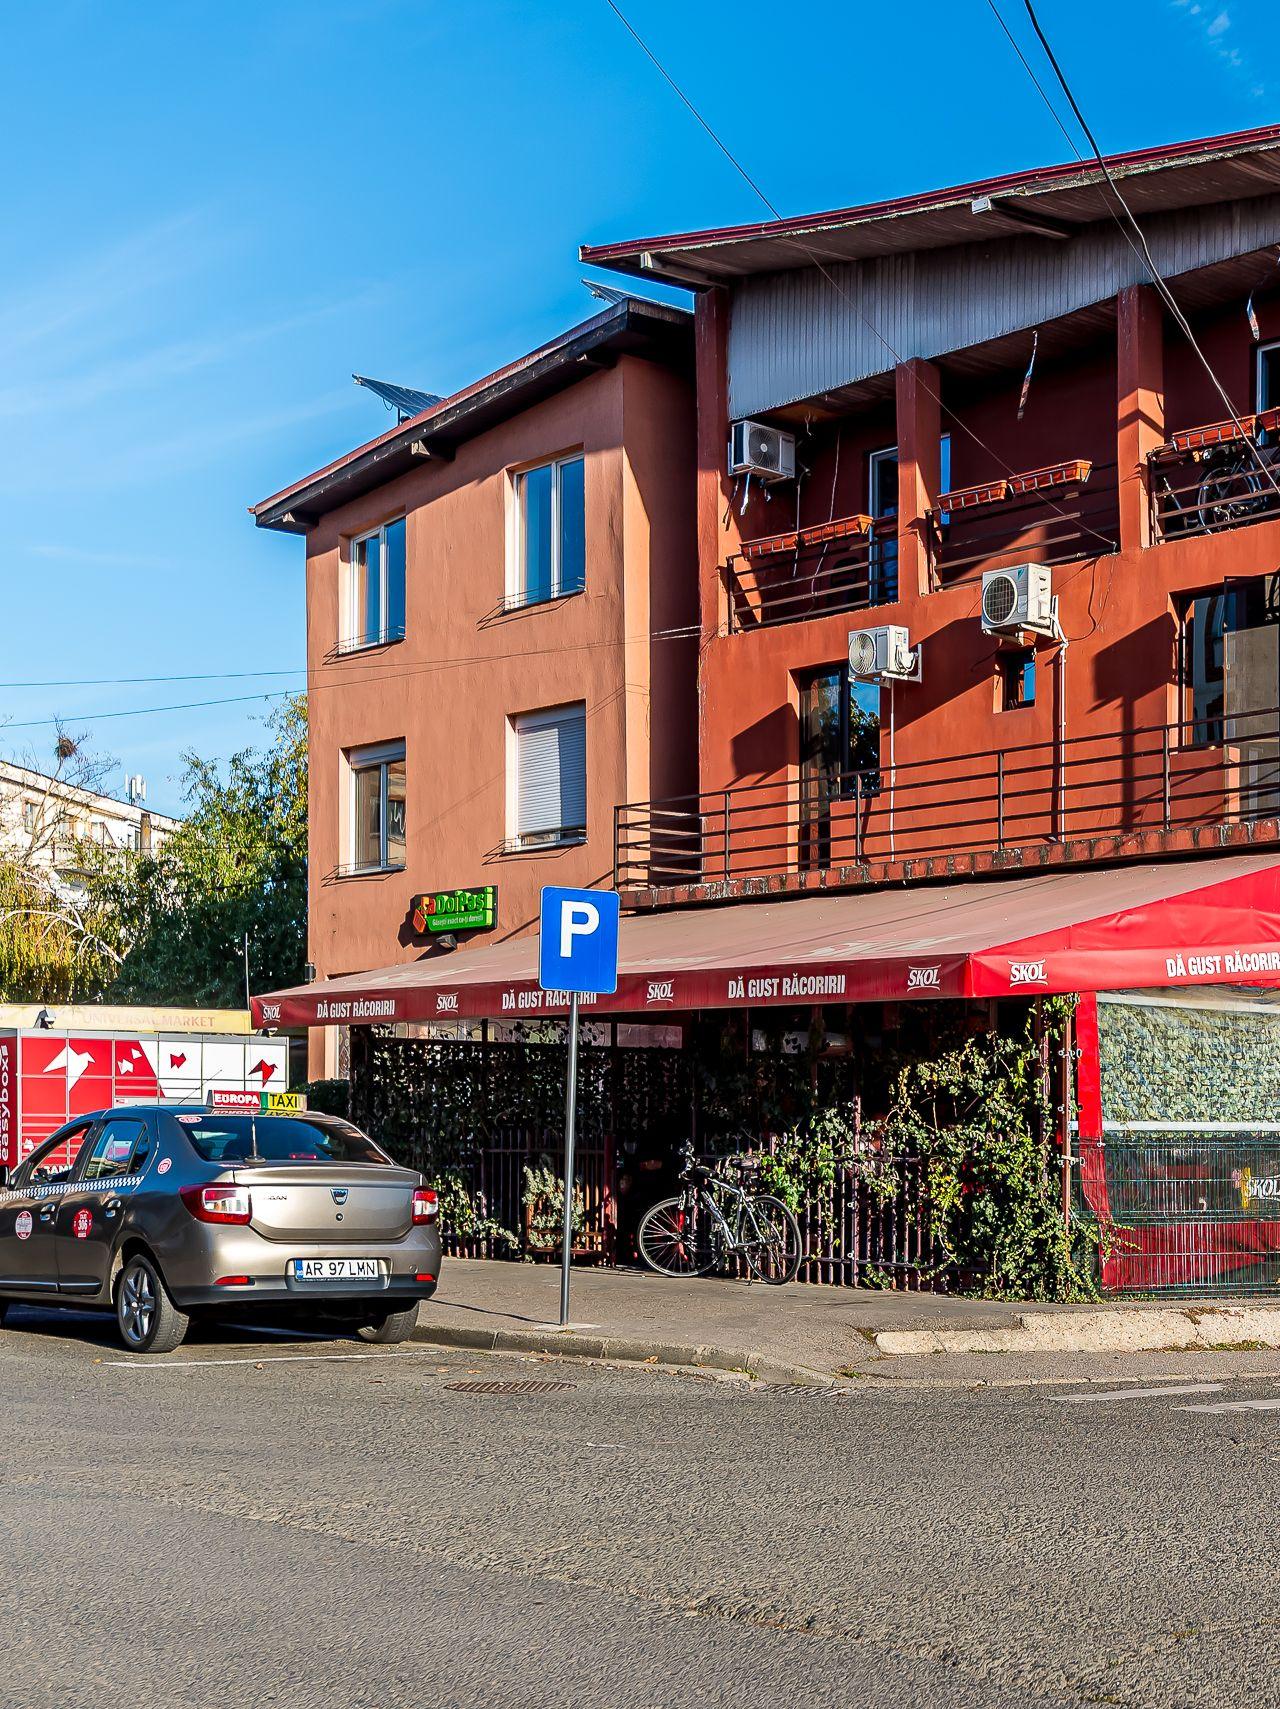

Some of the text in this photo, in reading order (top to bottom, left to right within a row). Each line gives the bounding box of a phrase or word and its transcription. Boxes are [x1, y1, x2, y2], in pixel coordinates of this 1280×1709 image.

[559, 900, 600, 958] P
[1010, 963, 1047, 983] SKOL
[1166, 953, 1187, 978] DĂ
[1188, 956, 1225, 975] GUST
[728, 973, 845, 998] DĂ GUST RĂCORIRII
[908, 968, 940, 987] SKOL
[502, 989, 516, 1010] DĂ
[518, 991, 544, 1009] GUST
[647, 984, 674, 1000] SKOL
[316, 998, 395, 1019] DĂ GUST RĂCORIRII
[436, 995, 459, 1010] SKOL
[160, 1016, 215, 1027] MARKET
[263, 1005, 281, 1020] SKOL
[214, 1092, 260, 1105] EUROPA
[270, 1093, 298, 1109] TAXI
[1, 1057, 10, 1161] easybox
[1245, 1178, 1280, 1199] SKOL
[305, 1262, 375, 1276] AR 97 LMN
